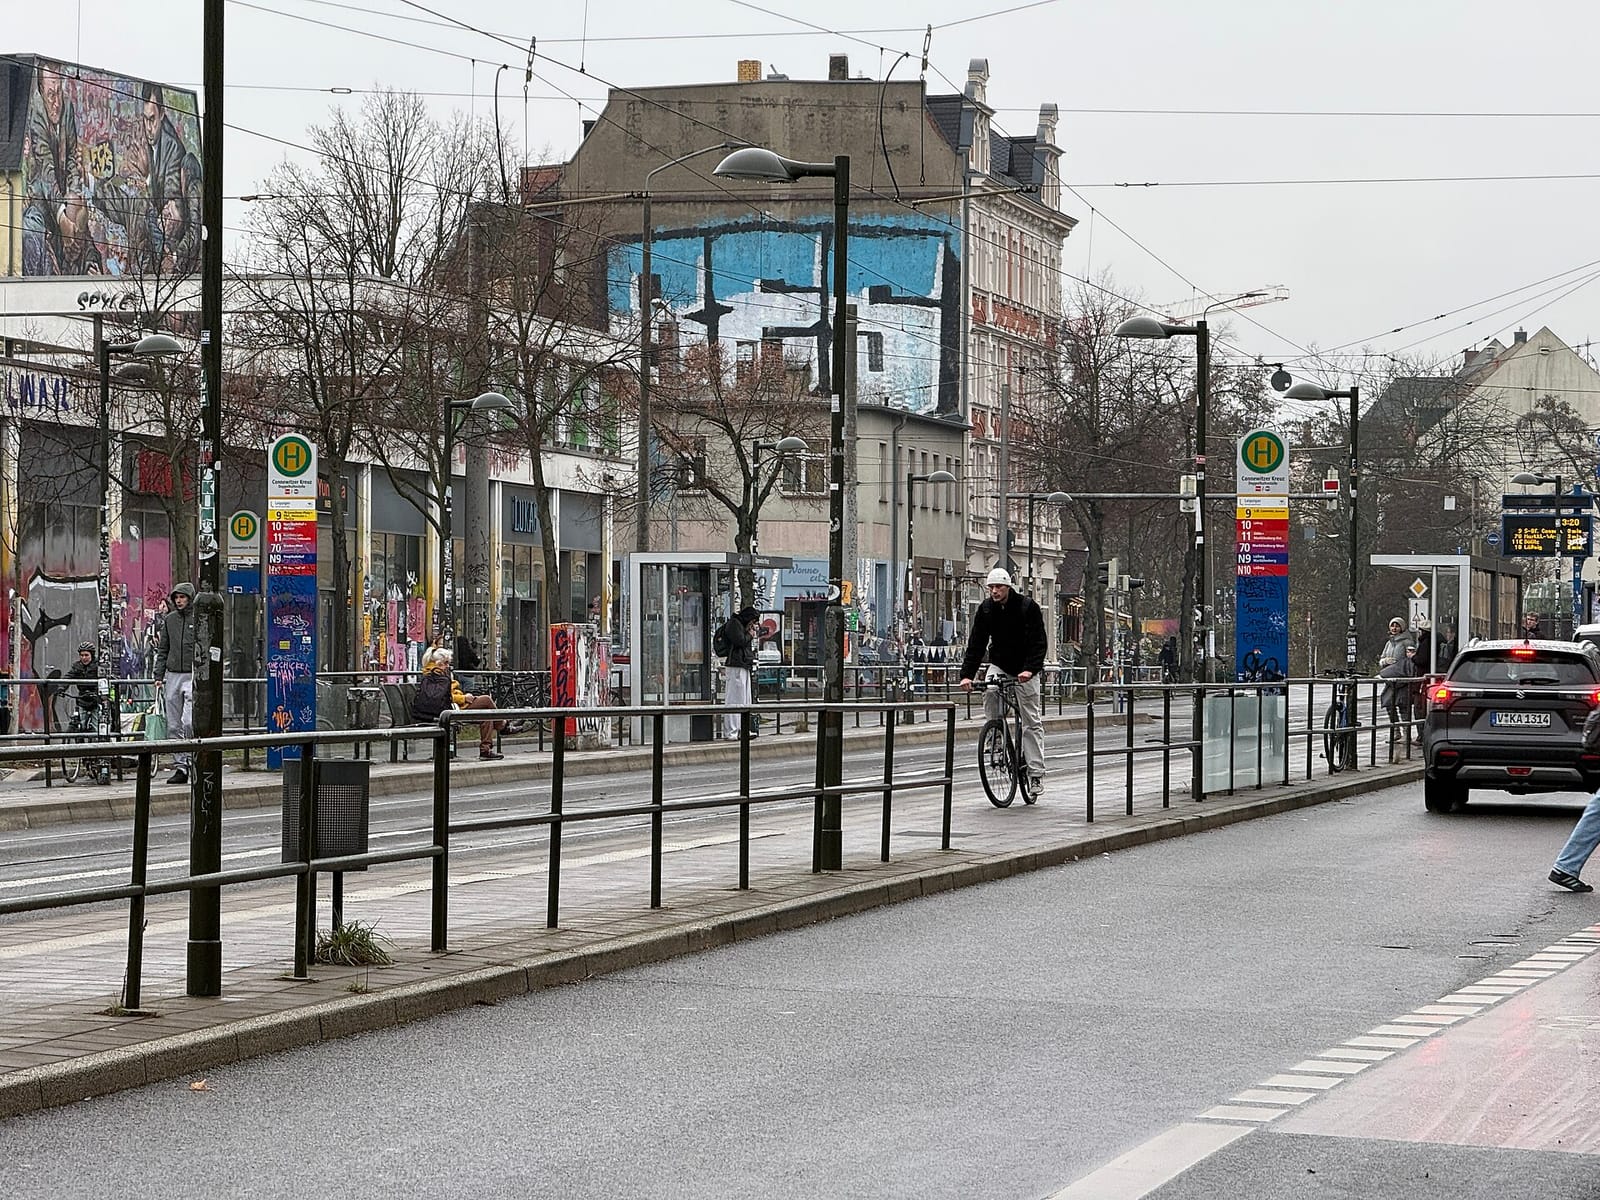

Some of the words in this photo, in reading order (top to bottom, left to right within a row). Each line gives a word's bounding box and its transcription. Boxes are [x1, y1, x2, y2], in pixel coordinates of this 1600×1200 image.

[284, 446, 300, 468] H
[1254, 440, 1272, 464] H
[276, 511, 282, 520] 9
[1245, 509, 1252, 518] 9
[238, 519, 248, 534] H
[272, 522, 282, 531] 10
[1241, 520, 1252, 530] 10
[273, 533, 282, 542] 11
[1241, 531, 1251, 541] 11
[270, 544, 282, 553] 70
[1239, 543, 1251, 552] 70
[269, 554, 282, 564] N9
[1238, 554, 1252, 564] N9
[1237, 565, 1252, 575] N10
[1497, 713, 1504, 723] V
[1510, 714, 1523, 723] KA
[1524, 714, 1549, 724] 1314
